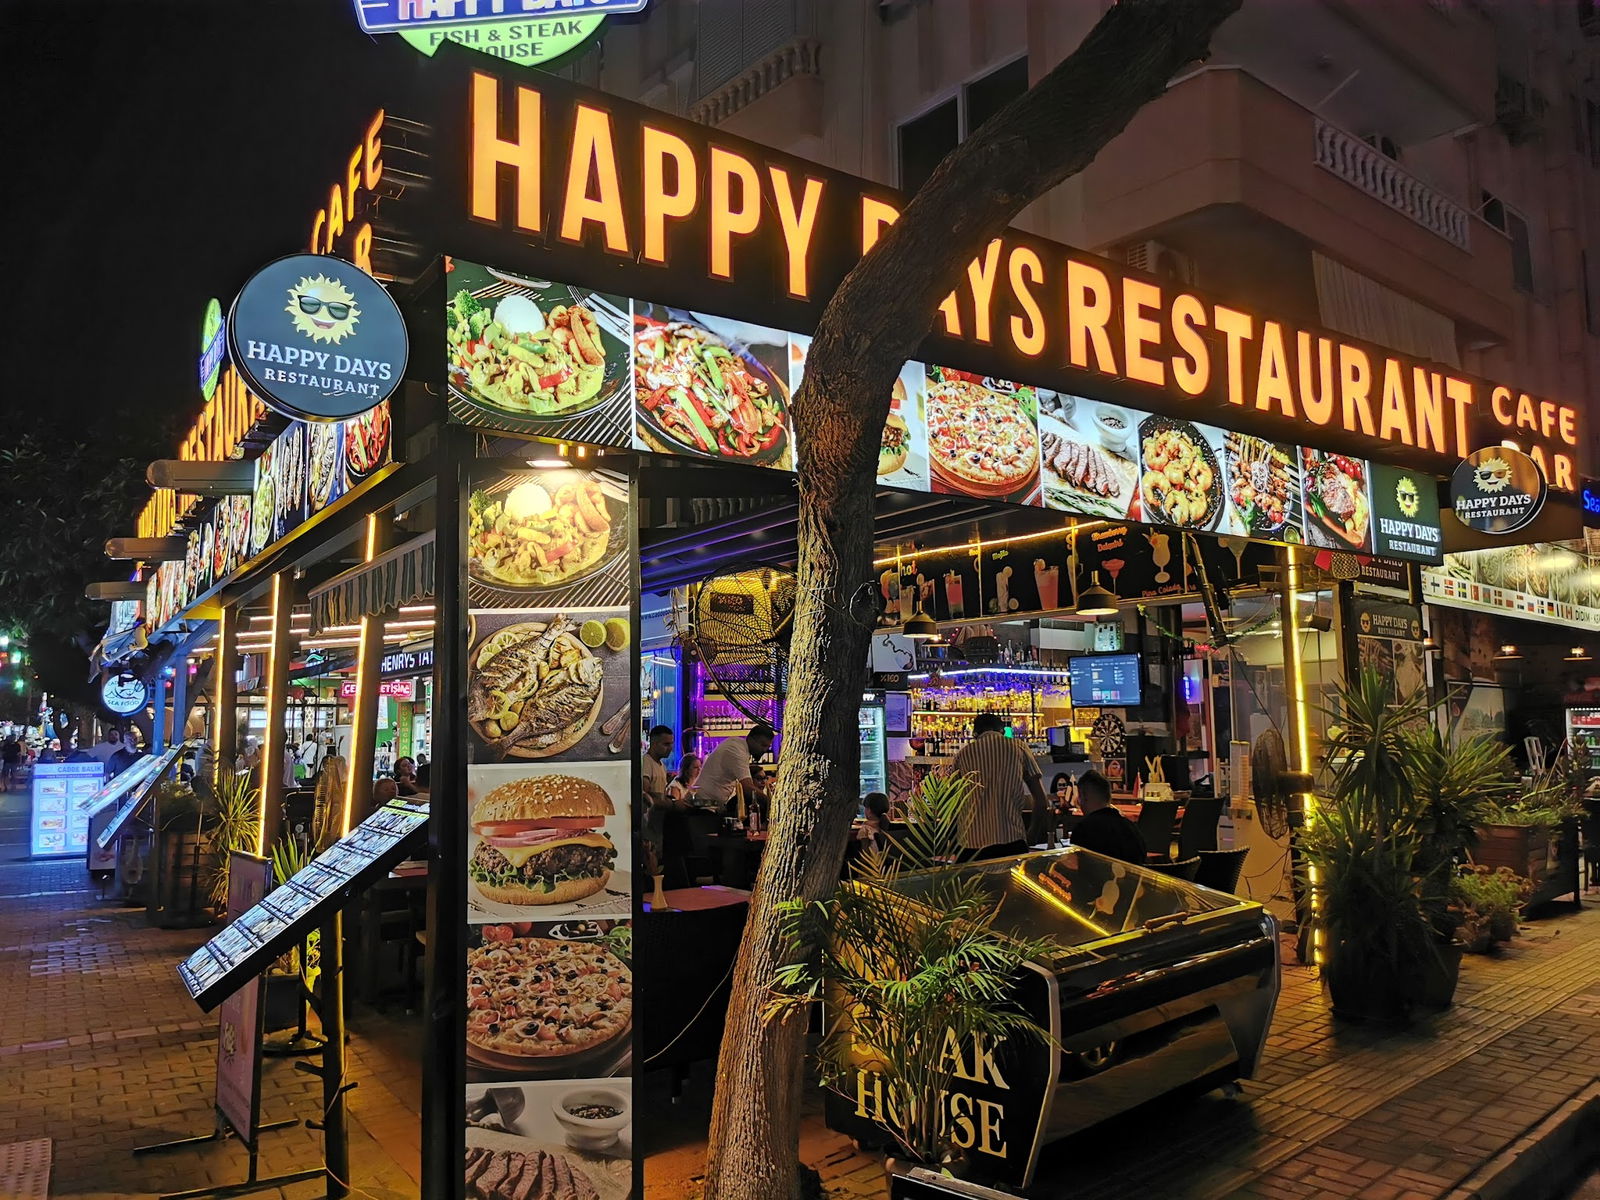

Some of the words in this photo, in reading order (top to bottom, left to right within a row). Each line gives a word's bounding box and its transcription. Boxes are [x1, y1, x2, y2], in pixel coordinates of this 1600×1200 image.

[488, 28, 501, 42] &
[509, 20, 582, 40] STEAK
[311, 109, 384, 254] CAFE
[472, 72, 823, 297] HAPPY
[862, 196, 1047, 356] YS
[1066, 259, 1473, 459] RESTAURANT
[247, 340, 330, 370] HAPPY
[334, 355, 391, 380] DAYS
[264, 368, 380, 396] RESTAURANT
[1491, 386, 1577, 446] CAFE
[1501, 440, 1575, 491] AR
[1456, 495, 1498, 511] HAPPY
[1500, 494, 1531, 506] DAYS
[1465, 507, 1525, 519] RESTAURANT
[1380, 518, 1414, 538] HAPPY
[1414, 524, 1441, 543] DAYS
[1389, 540, 1437, 557] RESTAURANT
[1361, 565, 1400, 581] RESTAURANT
[1372, 614, 1393, 627] HAPPY
[1394, 617, 1408, 629] DAYS
